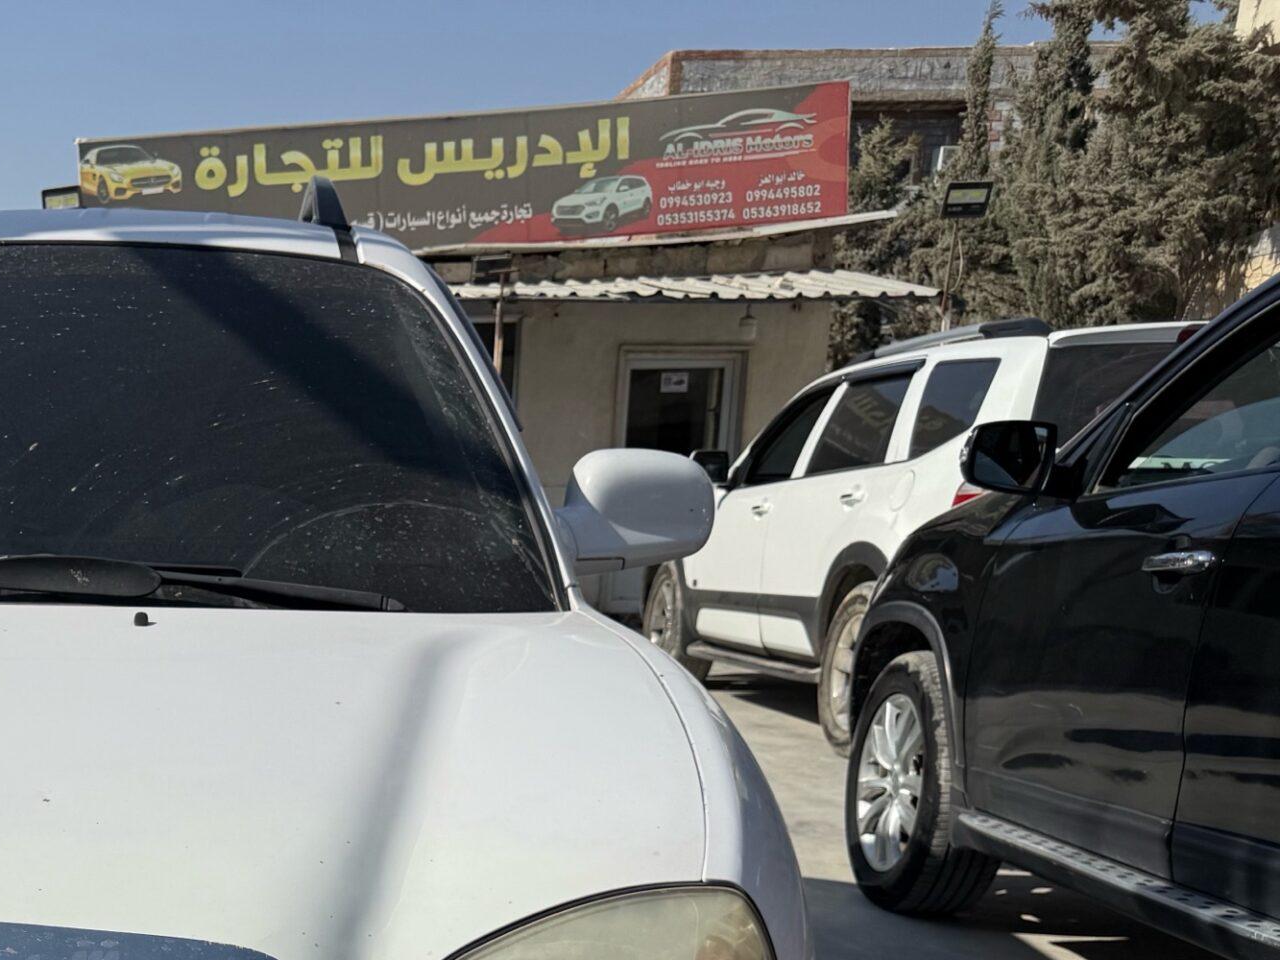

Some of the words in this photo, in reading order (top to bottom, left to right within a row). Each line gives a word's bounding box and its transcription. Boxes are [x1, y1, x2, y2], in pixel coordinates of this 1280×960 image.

[397, 116, 630, 187] الإدريس
[663, 137, 744, 160] AL-IDRIS
[746, 133, 815, 153] Motors
[194, 135, 384, 198] للتجارة
[660, 191, 733, 209] 0994530923
[746, 184, 821, 203] 0994495802
[385, 210, 436, 232] السيارات
[437, 205, 467, 230] أنواع
[470, 210, 500, 229] جميع
[500, 203, 533, 224] تجارة
[657, 209, 735, 226] 05353155374
[742, 202, 821, 220] 05363918652
